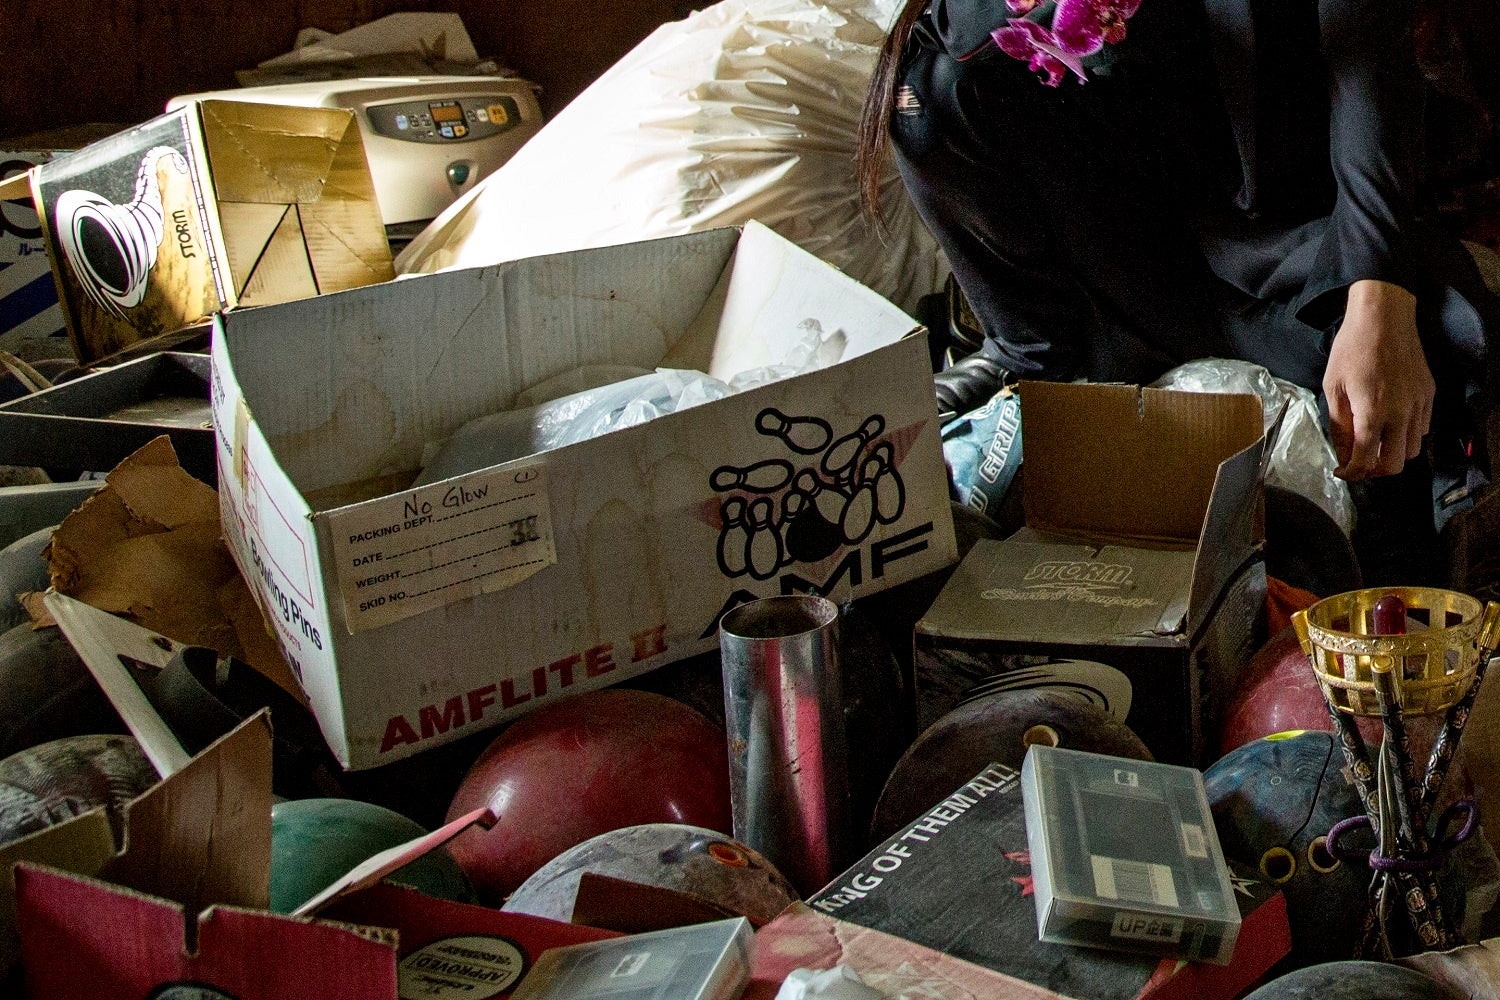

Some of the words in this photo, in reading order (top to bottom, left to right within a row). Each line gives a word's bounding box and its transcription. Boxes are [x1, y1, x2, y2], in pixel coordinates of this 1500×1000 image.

[172, 209, 196, 260] STORM
[978, 400, 1020, 485] GRIP
[403, 493, 433, 519] No
[442, 484, 489, 509] Glow
[349, 524, 401, 545] PACKING
[353, 552, 383, 568] DATE
[1023, 561, 1133, 584] STORM
[250, 536, 290, 623] Bowling
[290, 597, 323, 651] Pins
[356, 570, 401, 589] WEIGHT
[359, 597, 386, 613] SKID
[380, 642, 617, 754] AMFLITE
[813, 872, 884, 913] KING
[872, 842, 913, 873] OF
[900, 793, 979, 843] THEM
[415, 956, 505, 982] APPROVED
